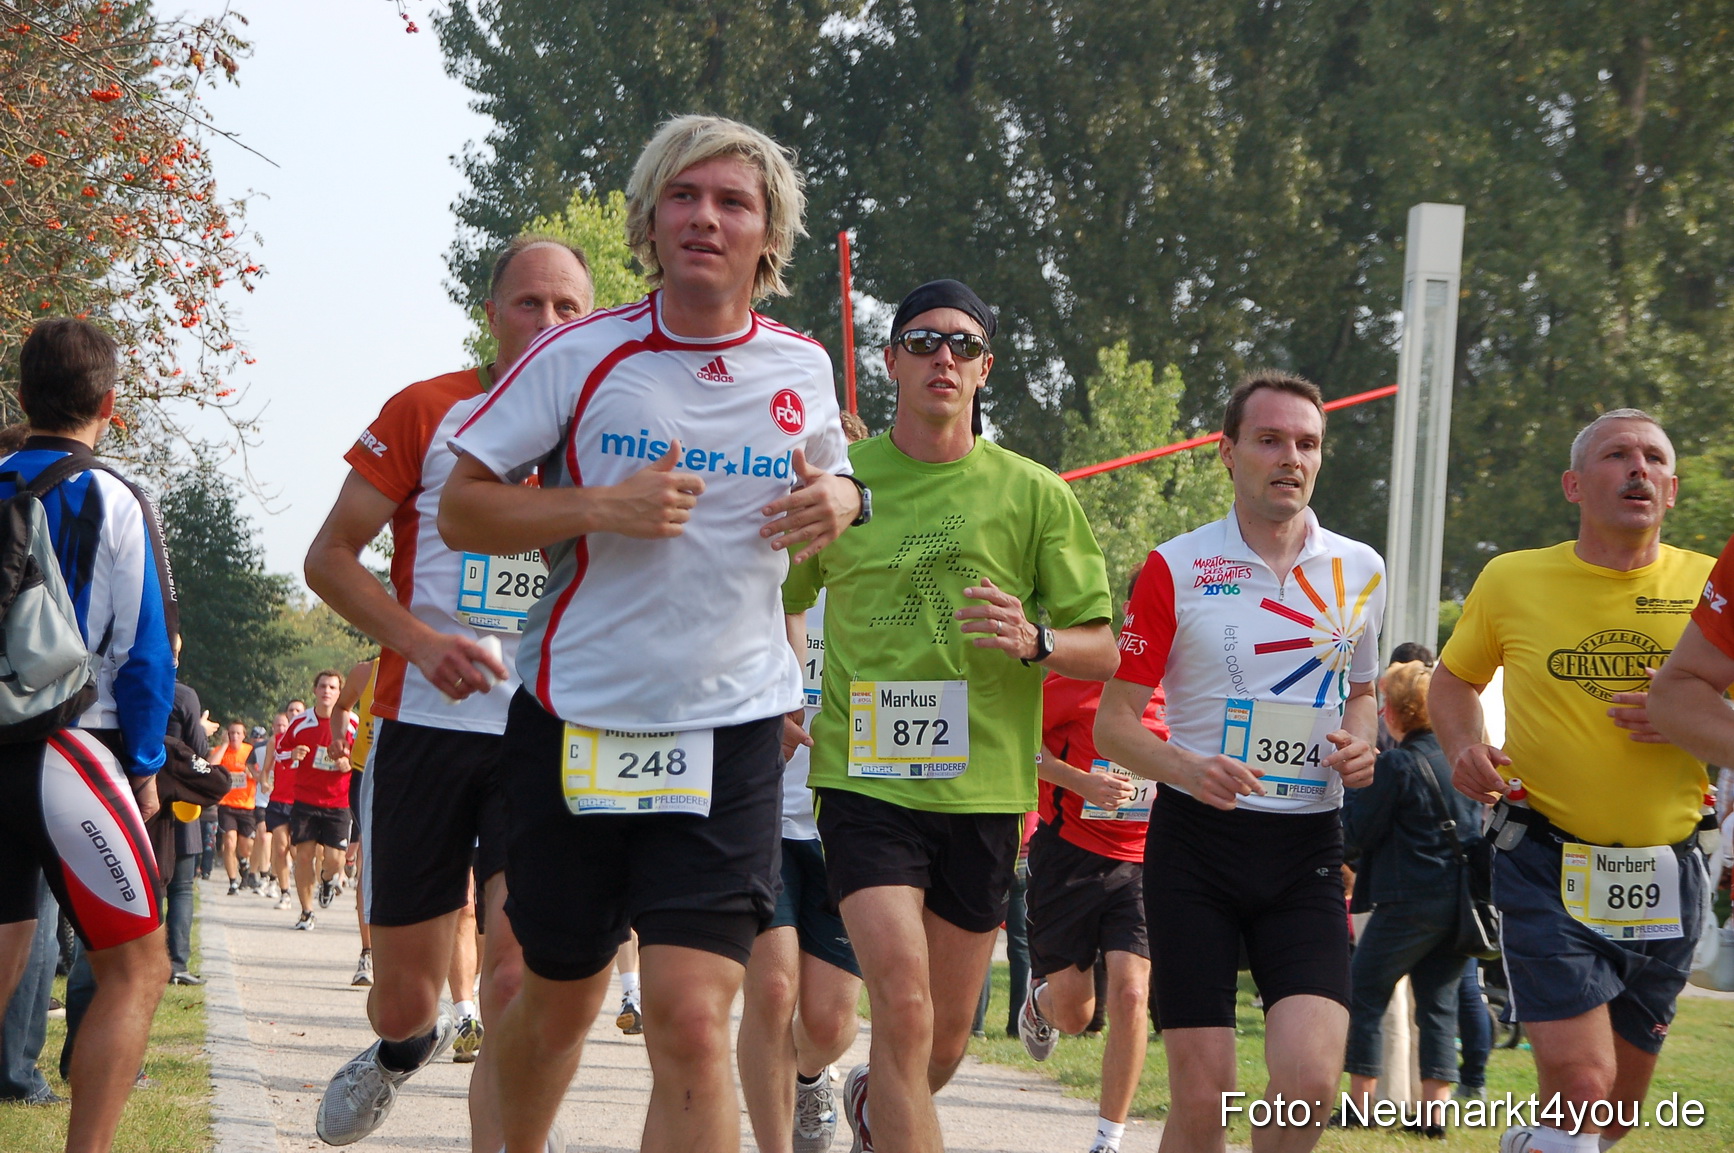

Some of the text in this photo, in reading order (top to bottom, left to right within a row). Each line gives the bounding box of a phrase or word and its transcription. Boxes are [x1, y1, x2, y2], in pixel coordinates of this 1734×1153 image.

[697, 371, 735, 383] adidas
[776, 406, 802, 425] FCN
[742, 446, 793, 479] lad
[469, 566, 477, 579] D
[1194, 565, 1253, 588] DOLOMITES
[1703, 580, 1728, 614] EZ
[1224, 624, 1239, 652] let's
[1580, 632, 1657, 653] PIZZERIA
[881, 688, 938, 708] Markus
[855, 718, 863, 732] C
[893, 719, 950, 746] 872
[569, 743, 579, 759] C
[1256, 738, 1321, 767] 3824
[617, 748, 687, 779] 248
[923, 762, 967, 772] PFLEIDERER
[654, 794, 709, 808] PFLEIDERER
[1596, 853, 1657, 873] Norbert
[1567, 878, 1576, 892] B
[1607, 883, 1660, 910] 869
